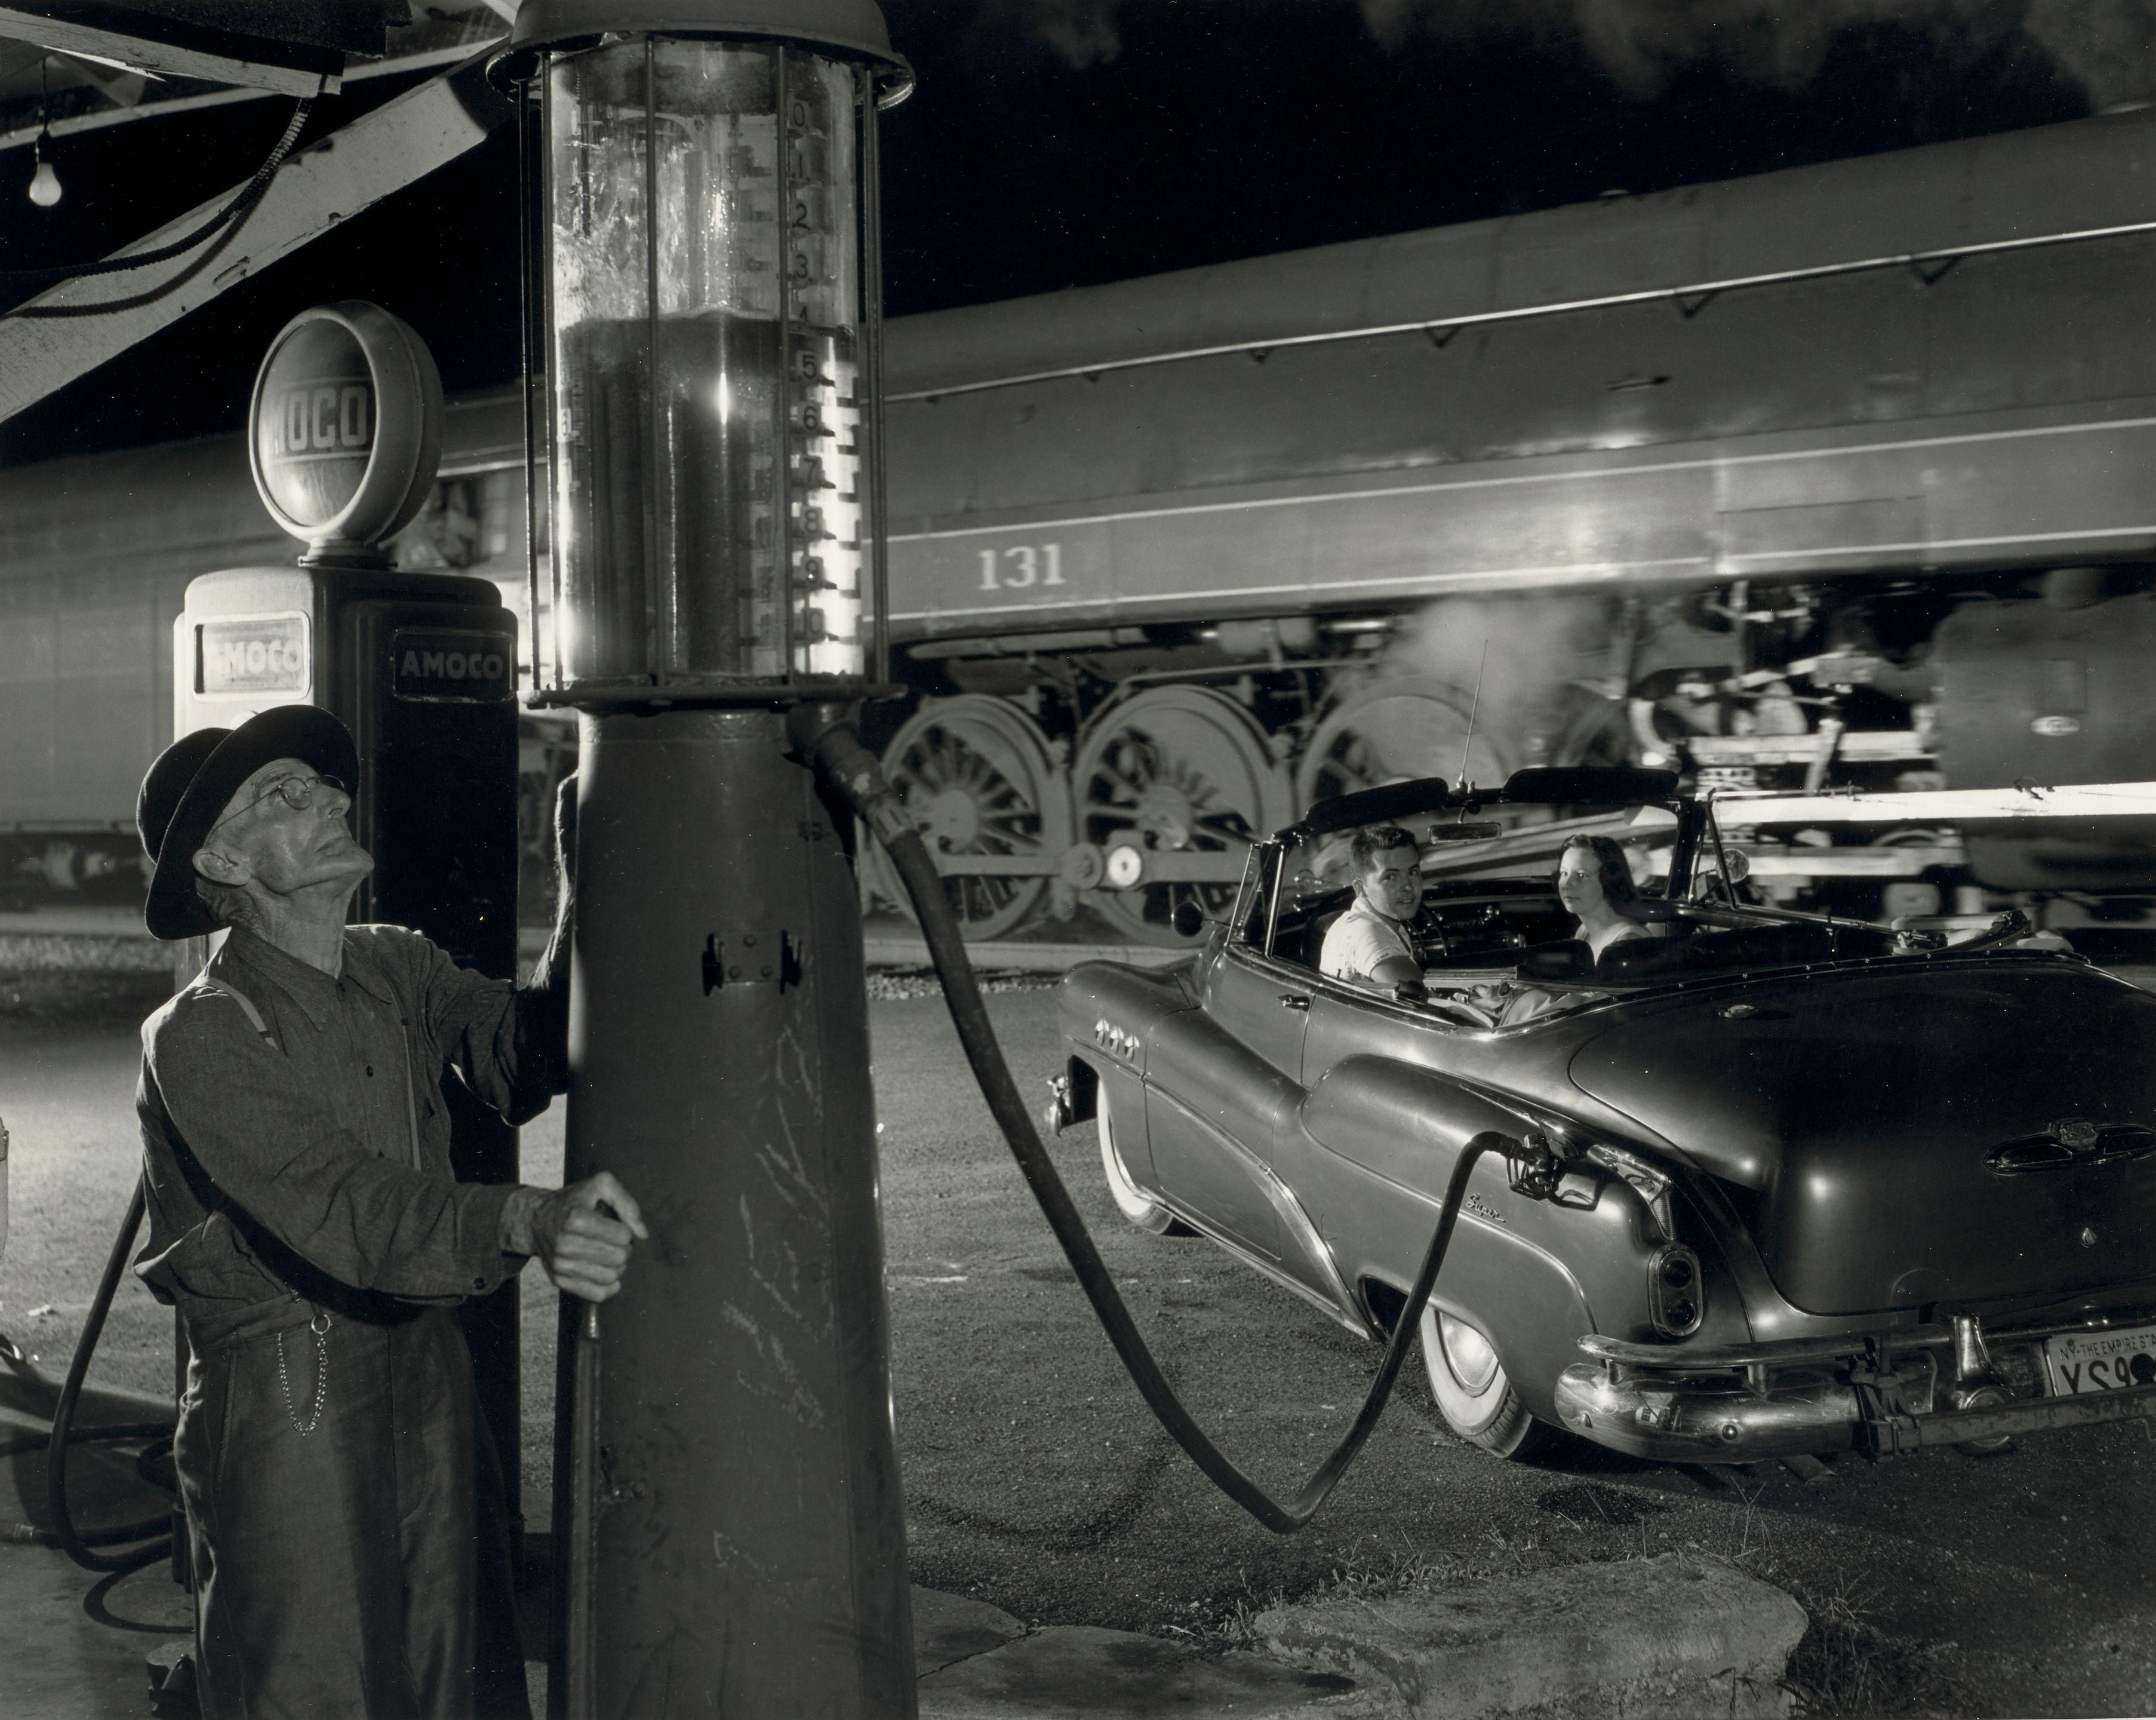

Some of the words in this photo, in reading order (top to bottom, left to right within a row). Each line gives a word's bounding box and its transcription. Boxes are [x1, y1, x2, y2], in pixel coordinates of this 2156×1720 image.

[793, 103, 805, 127] 0
[792, 203, 810, 231] 2
[796, 254, 808, 279] 3
[803, 354, 816, 379] 5
[804, 406, 817, 431] 6
[804, 457, 818, 481] 7
[806, 509, 817, 533] 8
[806, 559, 818, 583] 9
[978, 543, 1066, 590] 131
[400, 650, 503, 680] AMOCO
[1466, 1193, 1506, 1223] Super
[2100, 1337, 2137, 1357] EMPIRE
